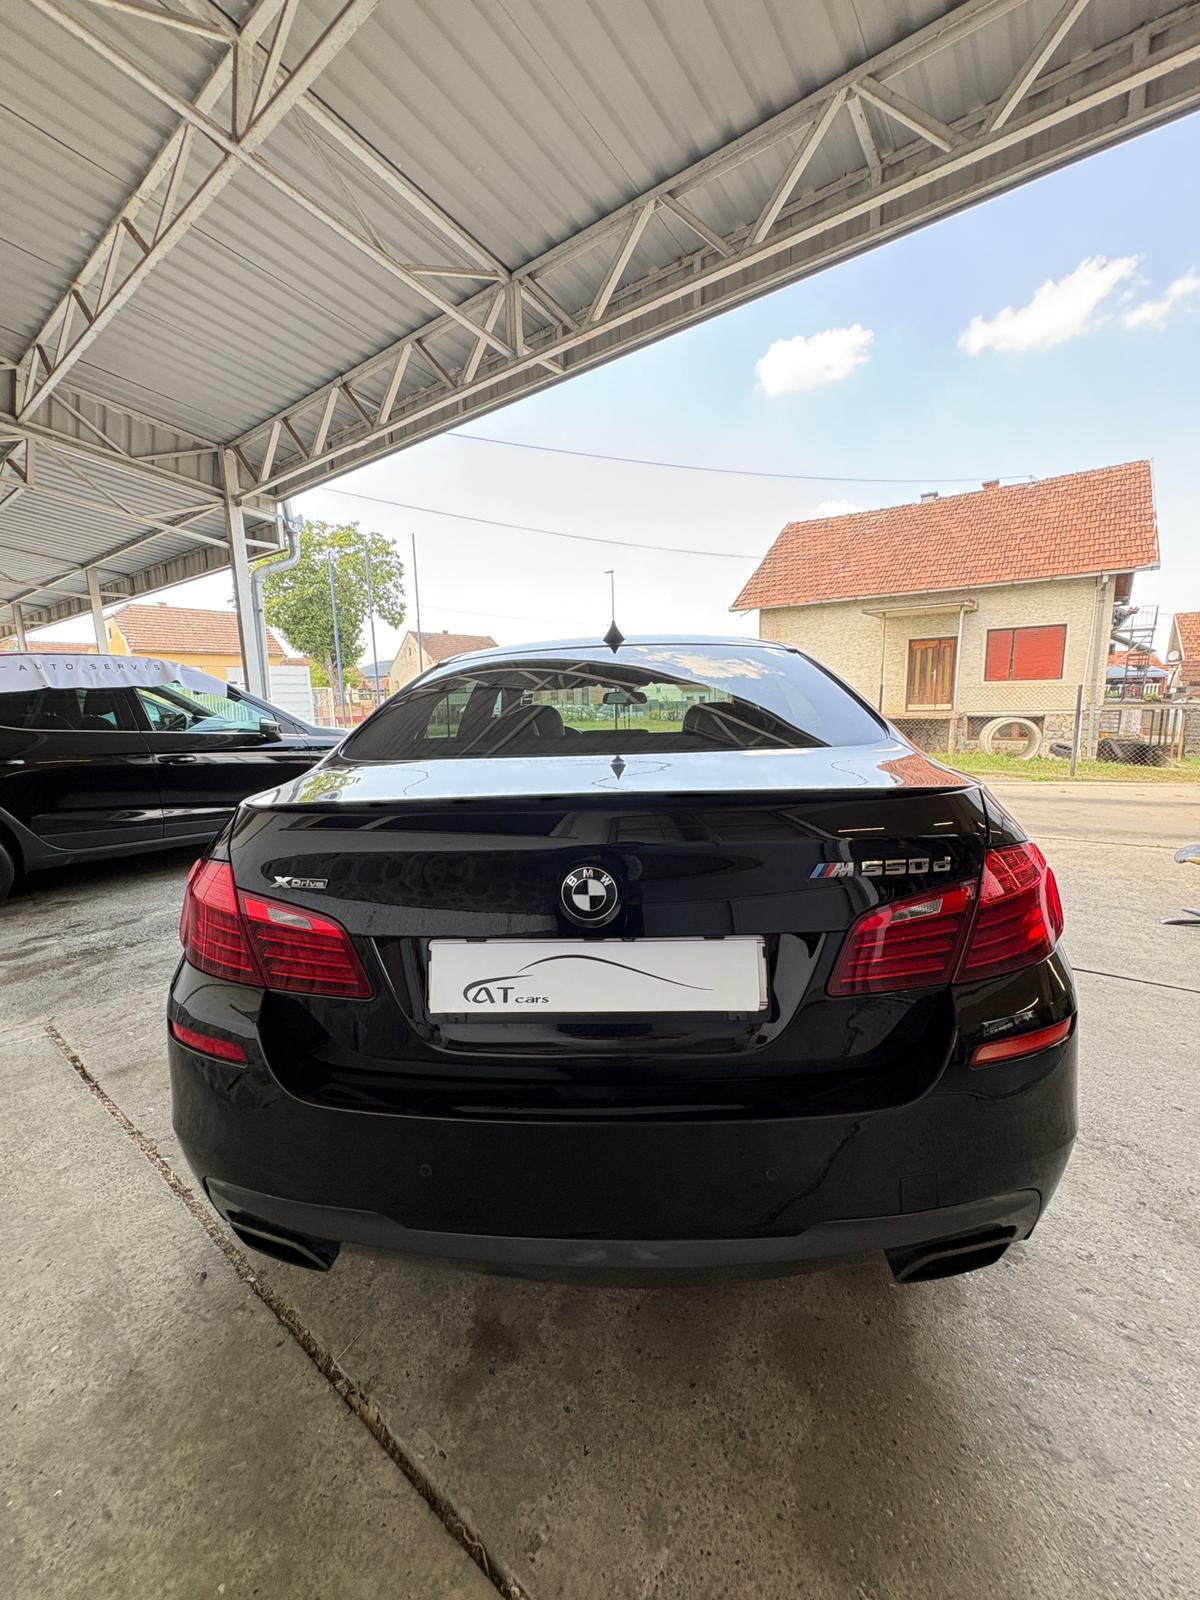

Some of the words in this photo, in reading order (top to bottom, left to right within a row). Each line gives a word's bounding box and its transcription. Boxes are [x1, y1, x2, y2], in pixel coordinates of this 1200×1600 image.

[18, 663, 74, 672] AUTO
[89, 663, 161, 671] SERVIS
[829, 861, 854, 877] M
[861, 856, 951, 876] 550d
[566, 868, 612, 887] BMW
